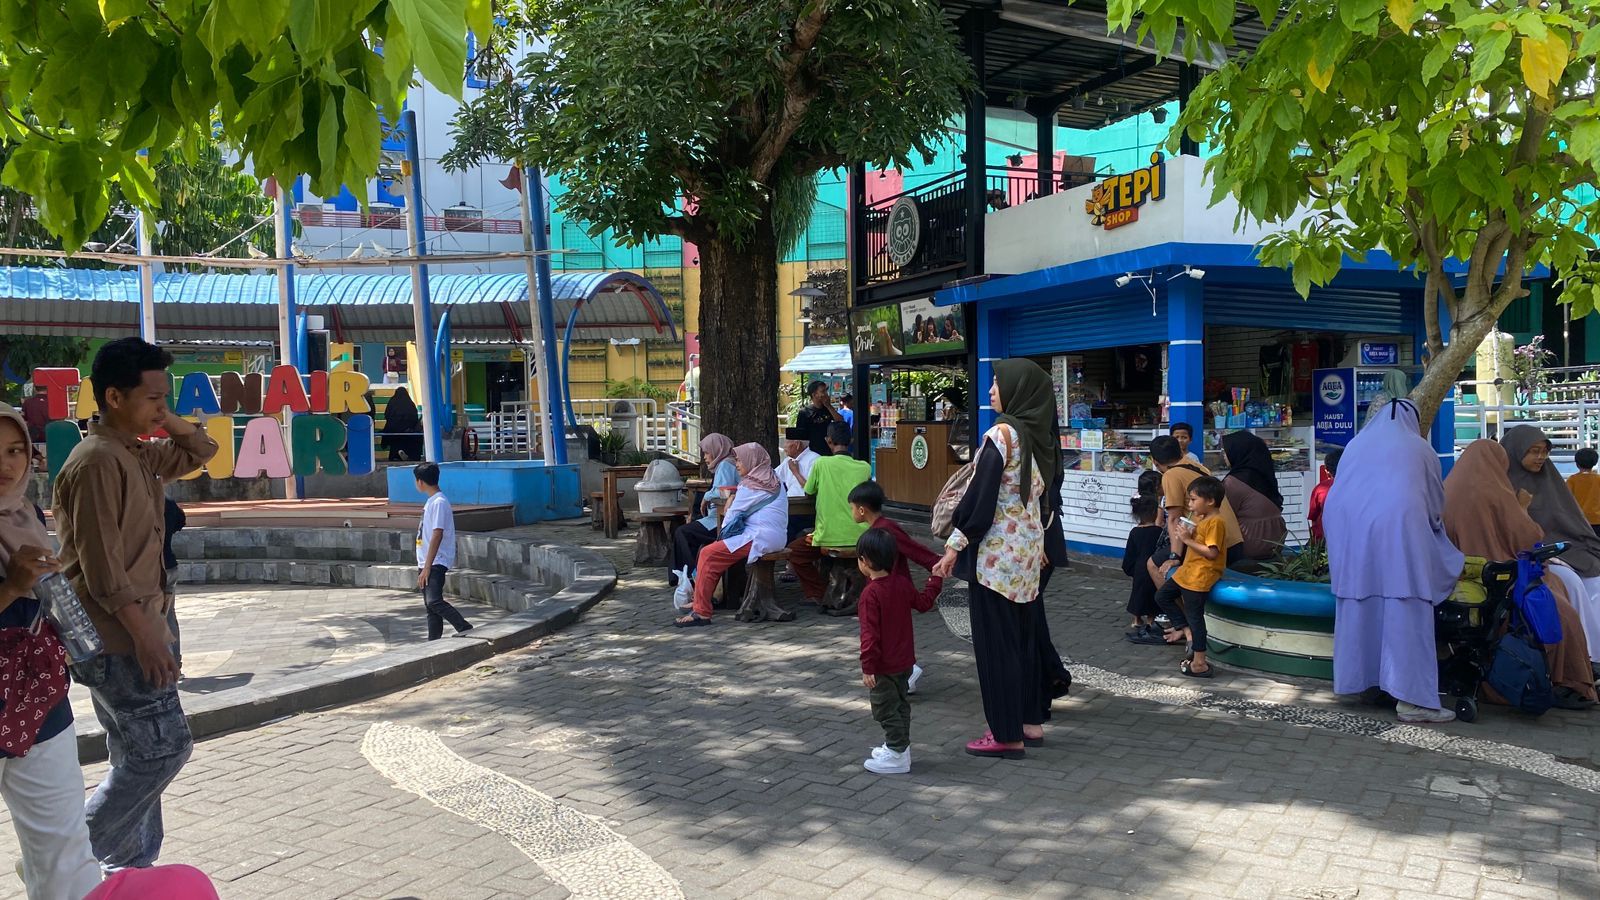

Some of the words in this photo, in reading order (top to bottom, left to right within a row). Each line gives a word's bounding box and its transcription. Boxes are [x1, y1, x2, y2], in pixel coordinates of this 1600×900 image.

[1106, 210, 1131, 226] SHOP
[1322, 381, 1342, 391] AQUA
[1316, 421, 1333, 430] AQUA
[1334, 421, 1353, 429] DULU
